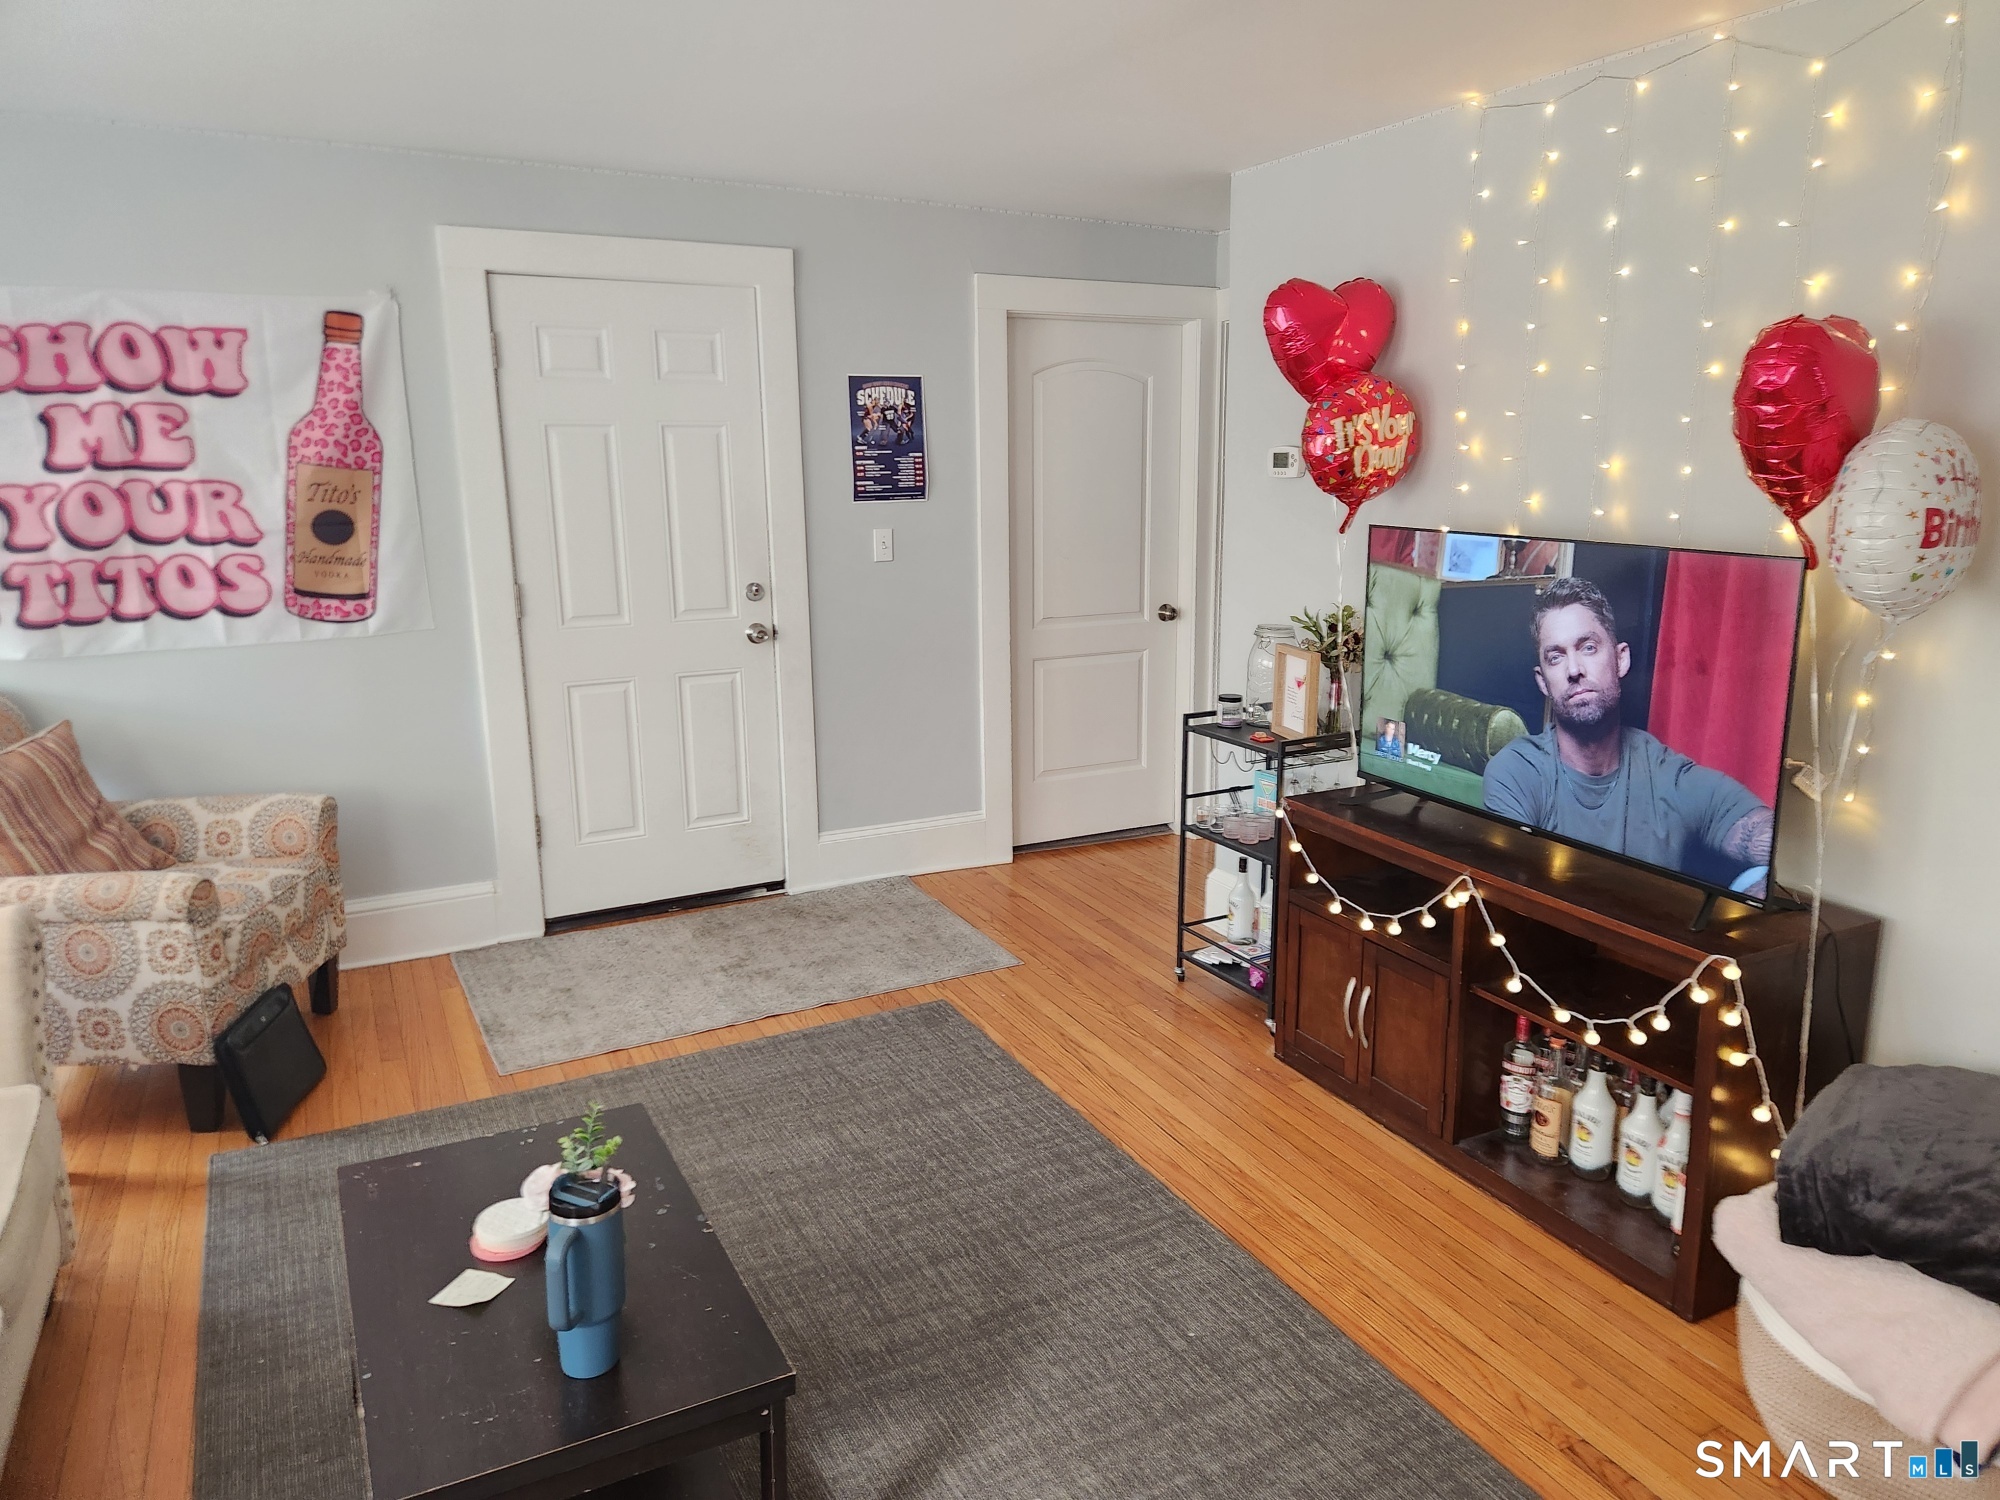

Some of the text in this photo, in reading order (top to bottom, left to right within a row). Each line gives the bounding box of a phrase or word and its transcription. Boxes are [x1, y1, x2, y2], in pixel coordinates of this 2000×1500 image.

[856, 386, 916, 406] SCHEDULE
[38, 401, 196, 472] ME
[306, 481, 363, 506] Tito's
[0, 478, 264, 553] YOUR
[294, 547, 368, 568] Handmade
[314, 569, 350, 580] VODKA
[2, 553, 273, 631] TITOS
